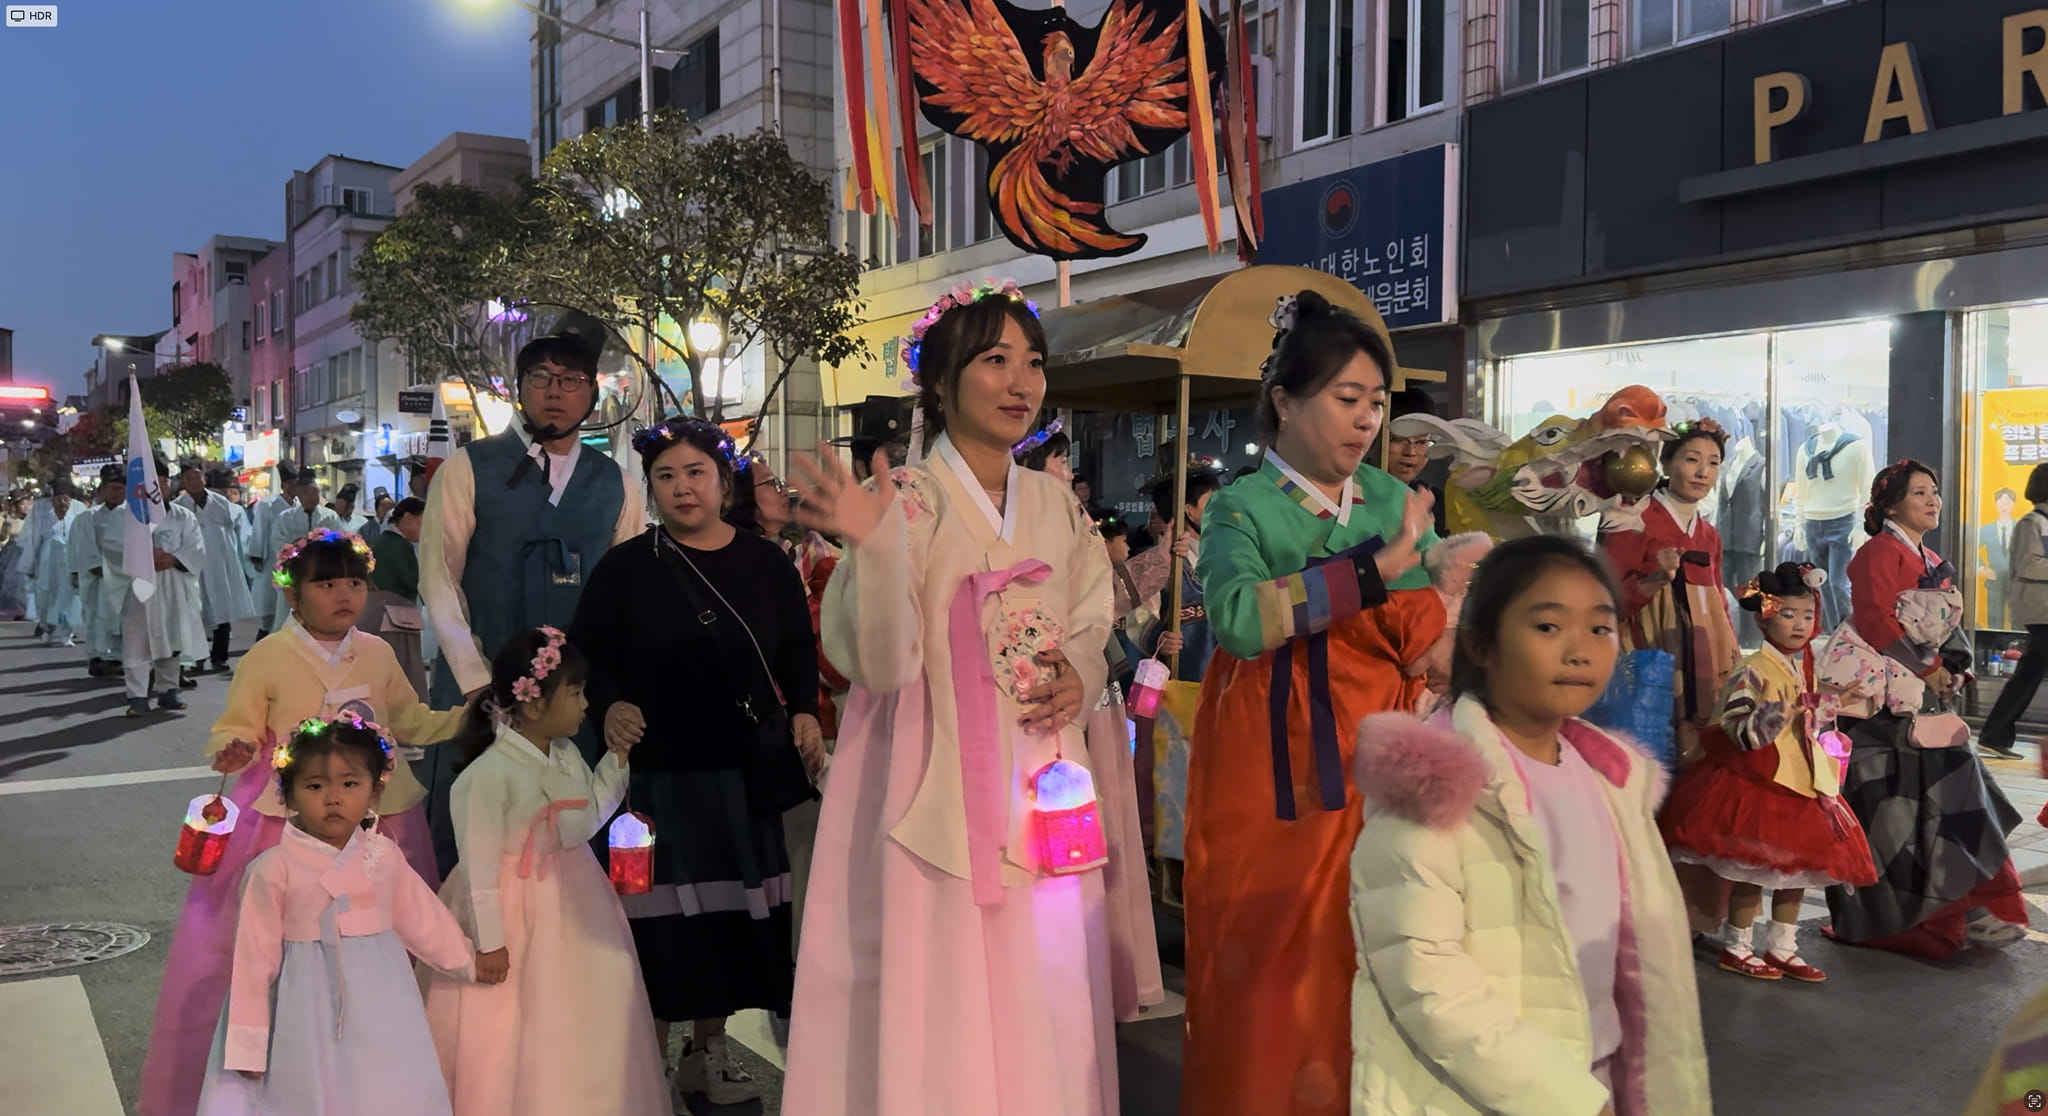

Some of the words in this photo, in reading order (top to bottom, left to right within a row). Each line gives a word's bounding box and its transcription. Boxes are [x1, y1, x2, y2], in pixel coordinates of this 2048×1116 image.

[1753, 8, 2048, 165] PAR
[1320, 233, 1429, 282] 대한노인회
[882, 335, 903, 377] 법
